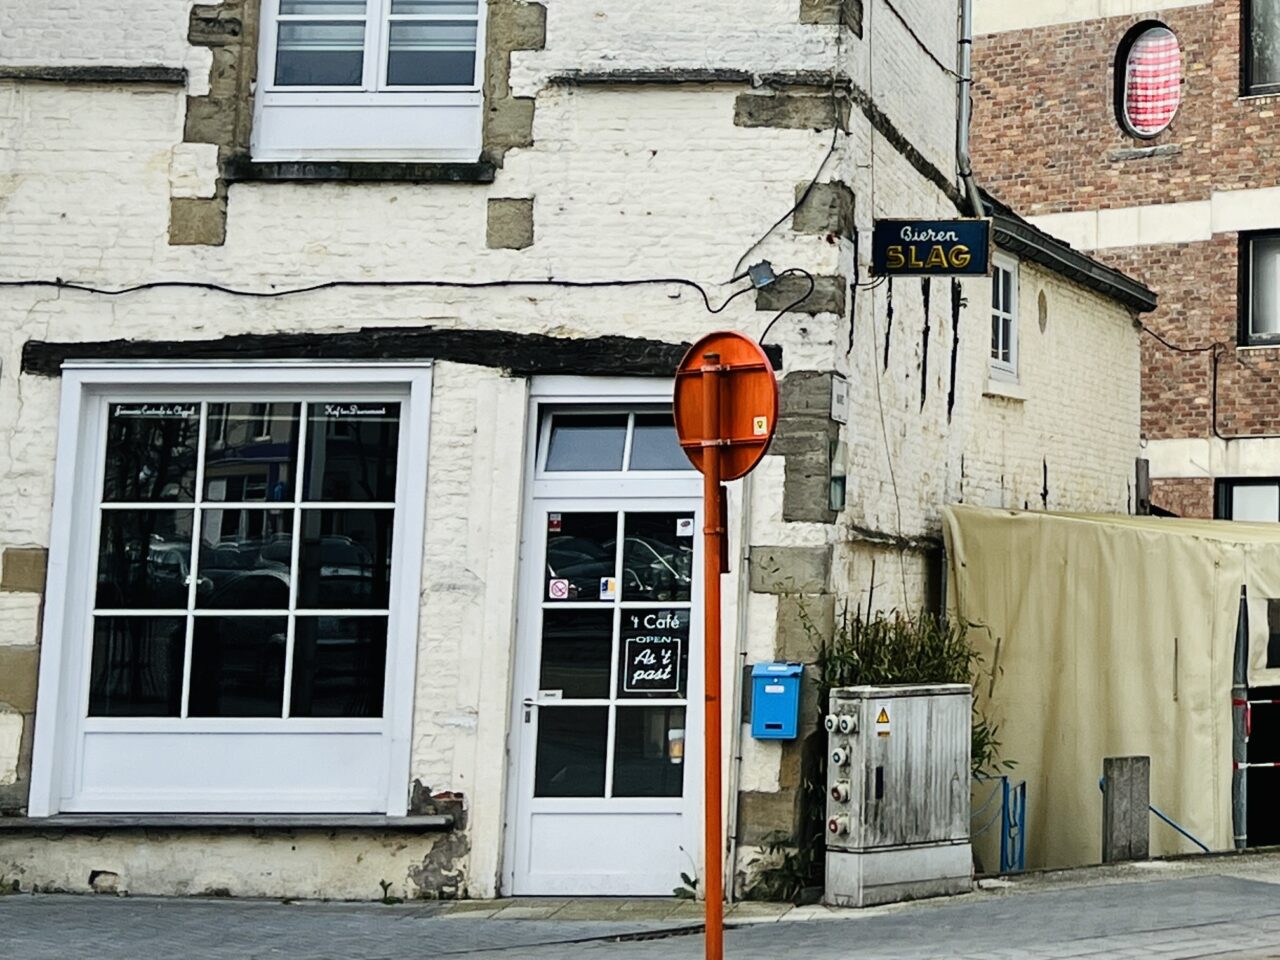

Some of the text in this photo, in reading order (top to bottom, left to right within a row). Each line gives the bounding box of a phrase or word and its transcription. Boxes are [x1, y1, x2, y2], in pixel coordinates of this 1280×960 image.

[900, 225, 959, 242] Bieren
[886, 244, 972, 269] SLAG
[630, 613, 680, 629] 't Café
[633, 648, 656, 665] As
[631, 664, 672, 685] past
